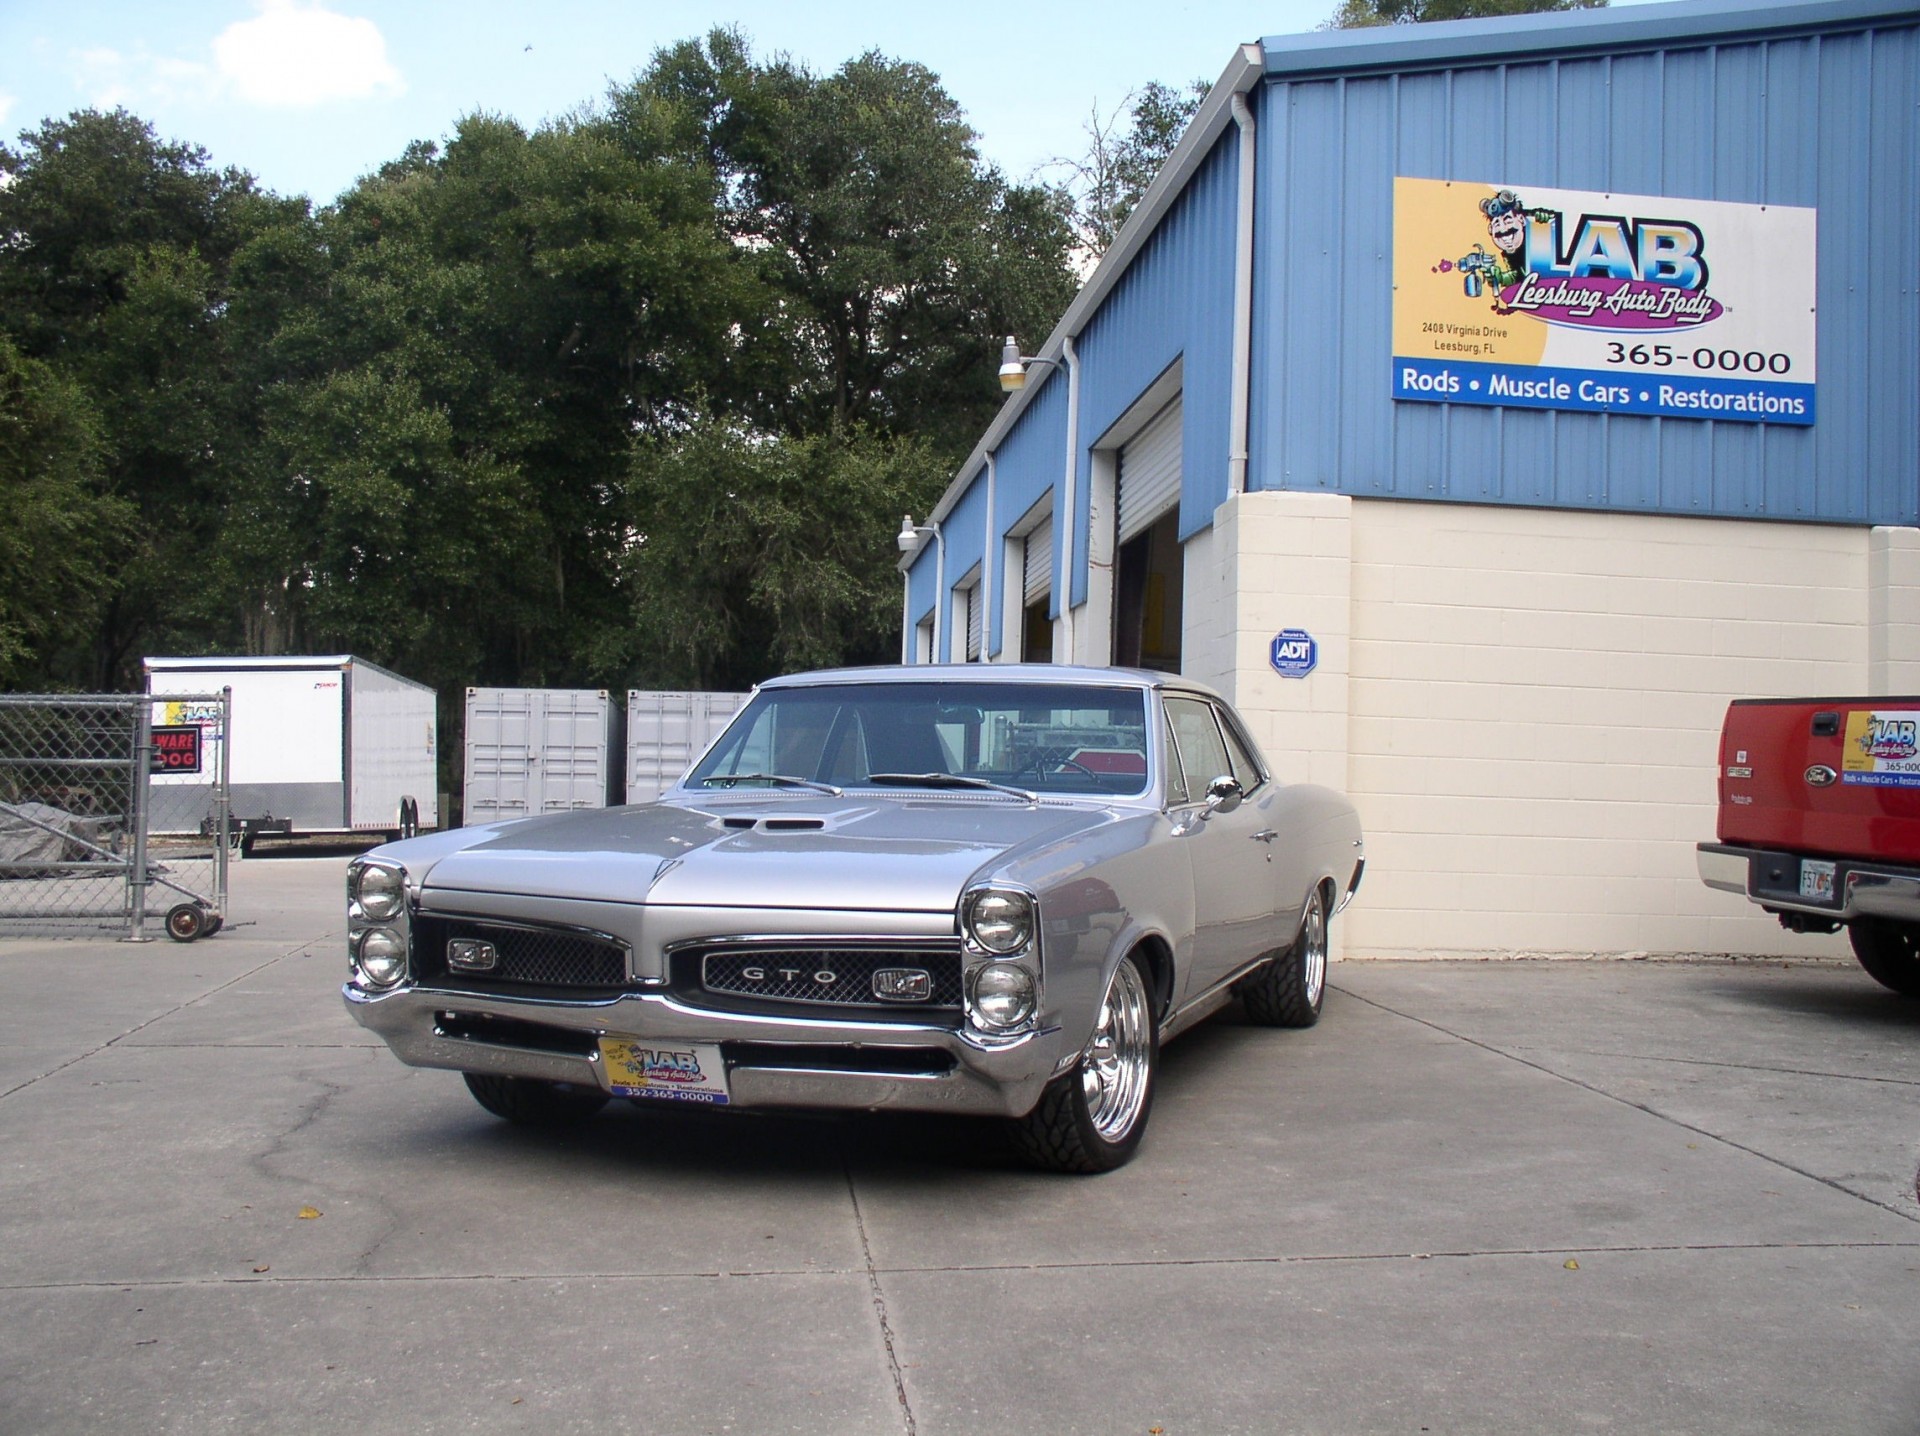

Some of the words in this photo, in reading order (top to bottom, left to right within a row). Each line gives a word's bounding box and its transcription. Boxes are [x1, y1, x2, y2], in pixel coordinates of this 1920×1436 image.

[1524, 211, 1708, 292] LAB
[1508, 273, 1602, 316] Leesburg
[1603, 283, 1656, 316] Auto
[1650, 287, 1713, 324] Body
[1422, 322, 1444, 334] 2408
[1446, 324, 1481, 338] Virginia
[1483, 326, 1508, 338] Drive
[1434, 340, 1482, 355] Leesburg,
[1483, 343, 1496, 354] FL
[1606, 342, 1791, 374] 365-0000
[1402, 368, 1460, 393] Rods
[1488, 374, 1571, 400] Muscle
[1578, 380, 1630, 404] Cars
[1659, 385, 1805, 415] Restorations
[1277, 642, 1310, 659] ADT
[1873, 720, 1916, 747] LAB
[1807, 769, 1826, 782] Ford
[743, 967, 837, 983] GTO
[642, 1049, 701, 1074] LAB
[625, 1087, 714, 1103] 352-365-0000
